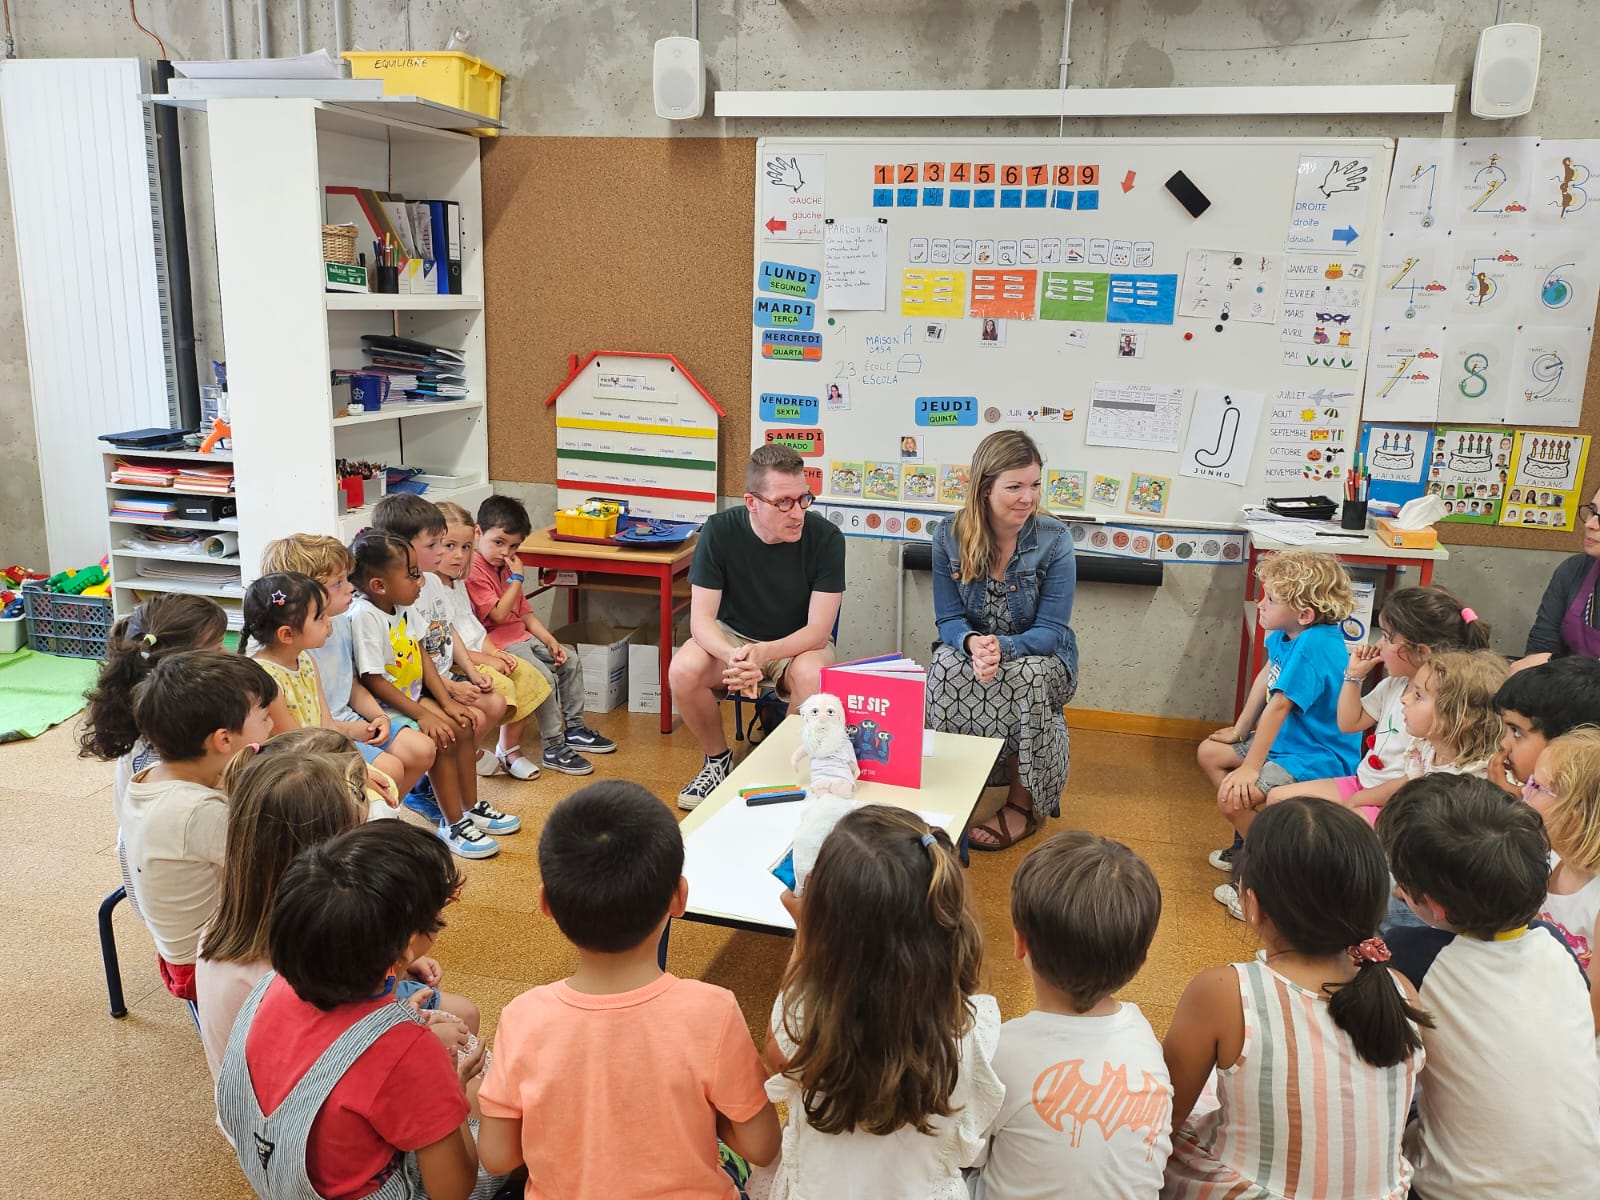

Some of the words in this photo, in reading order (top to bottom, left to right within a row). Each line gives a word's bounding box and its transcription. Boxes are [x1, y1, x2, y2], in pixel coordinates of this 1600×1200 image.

[374, 58, 428, 70] EQUILIBRE
[878, 167, 886, 183] 1
[903, 166, 914, 183] 2
[929, 164, 940, 182] 3
[954, 164, 966, 182] 4
[978, 166, 990, 183] 5
[1006, 167, 1018, 184] 6
[1031, 166, 1044, 184] 7
[1057, 167, 1069, 184] 8
[1082, 167, 1094, 184] 9
[789, 197, 822, 205] GAUCHE
[1295, 202, 1328, 211] DROITE
[792, 211, 822, 221] gauche
[1293, 218, 1320, 227] droite
[1287, 264, 1319, 274] JANVIER
[765, 265, 817, 285] LUNDI
[770, 281, 807, 293] SEGUNDA
[758, 301, 812, 317] MARDI
[1284, 309, 1304, 319] MARS
[773, 315, 799, 324] TERÇA
[1282, 328, 1303, 338] AVRIL
[765, 333, 820, 344] MERCREDI
[865, 335, 899, 345] MAISON
[772, 348, 803, 356] QUARTA
[869, 345, 892, 353] CASA
[1284, 351, 1299, 359] MAI
[862, 375, 898, 385] ESCOLA
[1277, 391, 1306, 400] JUILLET
[761, 395, 818, 408] VENDREDI
[920, 400, 973, 411] JEUDI
[776, 408, 800, 416] SEXTA
[929, 414, 958, 424] QUINTA
[766, 432, 823, 442] SAMEDI
[1194, 407, 1241, 468] J
[1270, 428, 1309, 438] SEPTEMBRE
[1269, 448, 1302, 457] OCTOBRE
[1193, 467, 1231, 479] JUNHO
[1265, 468, 1302, 477] NOVEMBRE
[1395, 473, 1411, 481] ANS
[1471, 475, 1488, 483] ANS
[1525, 478, 1541, 486] J'AI
[851, 515, 859, 526] 6
[1135, 539, 1148, 549] 20
[847, 694, 865, 710] ET
[866, 696, 891, 717] SI?
